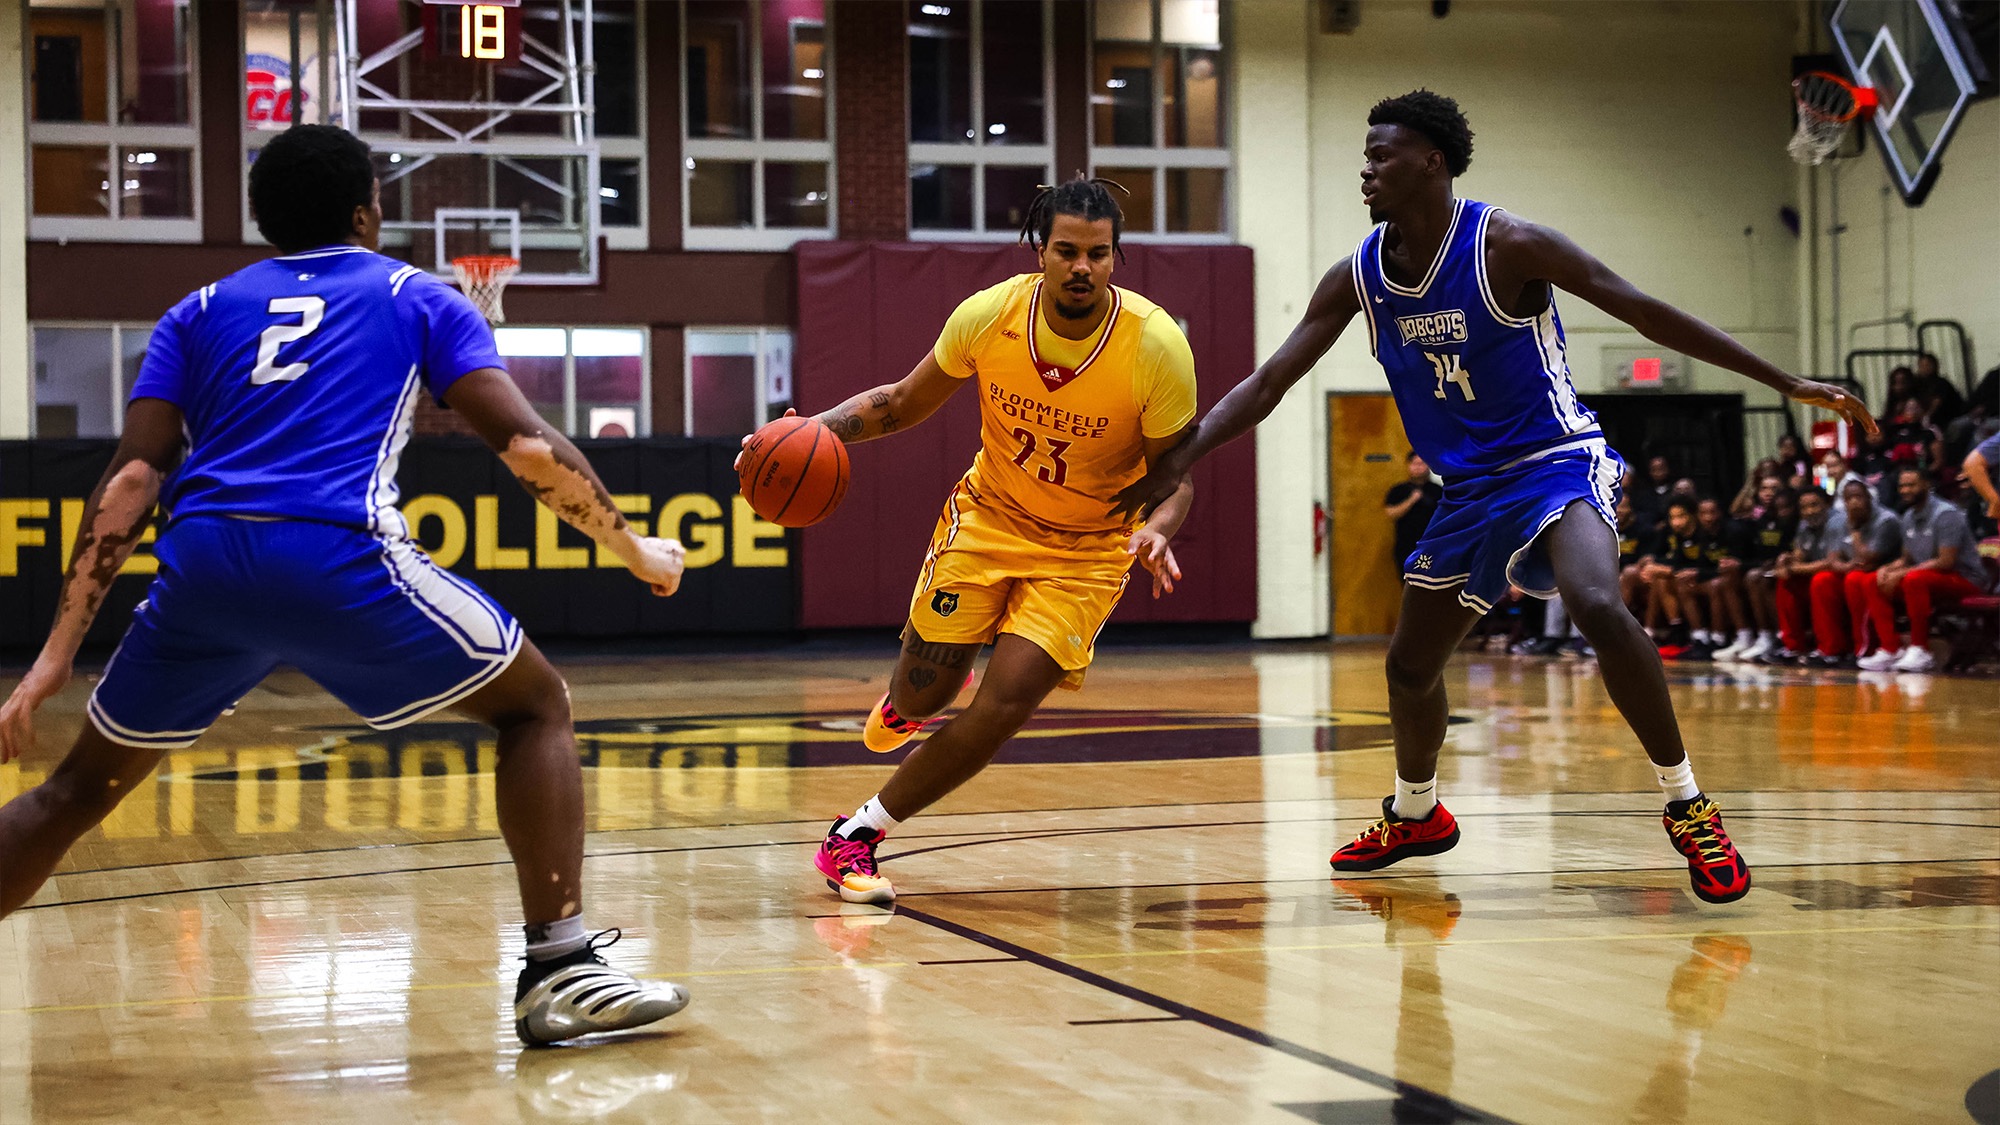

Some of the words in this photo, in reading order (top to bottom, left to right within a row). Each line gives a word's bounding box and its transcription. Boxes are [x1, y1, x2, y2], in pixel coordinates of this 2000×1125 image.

[461, 4, 505, 60] 18
[250, 296, 327, 385] 2
[989, 381, 1110, 429] BLOOMFIELD
[990, 394, 1105, 439] COLLEGE
[1012, 425, 1074, 487] 23
[400, 492, 789, 570] OLLEGE
